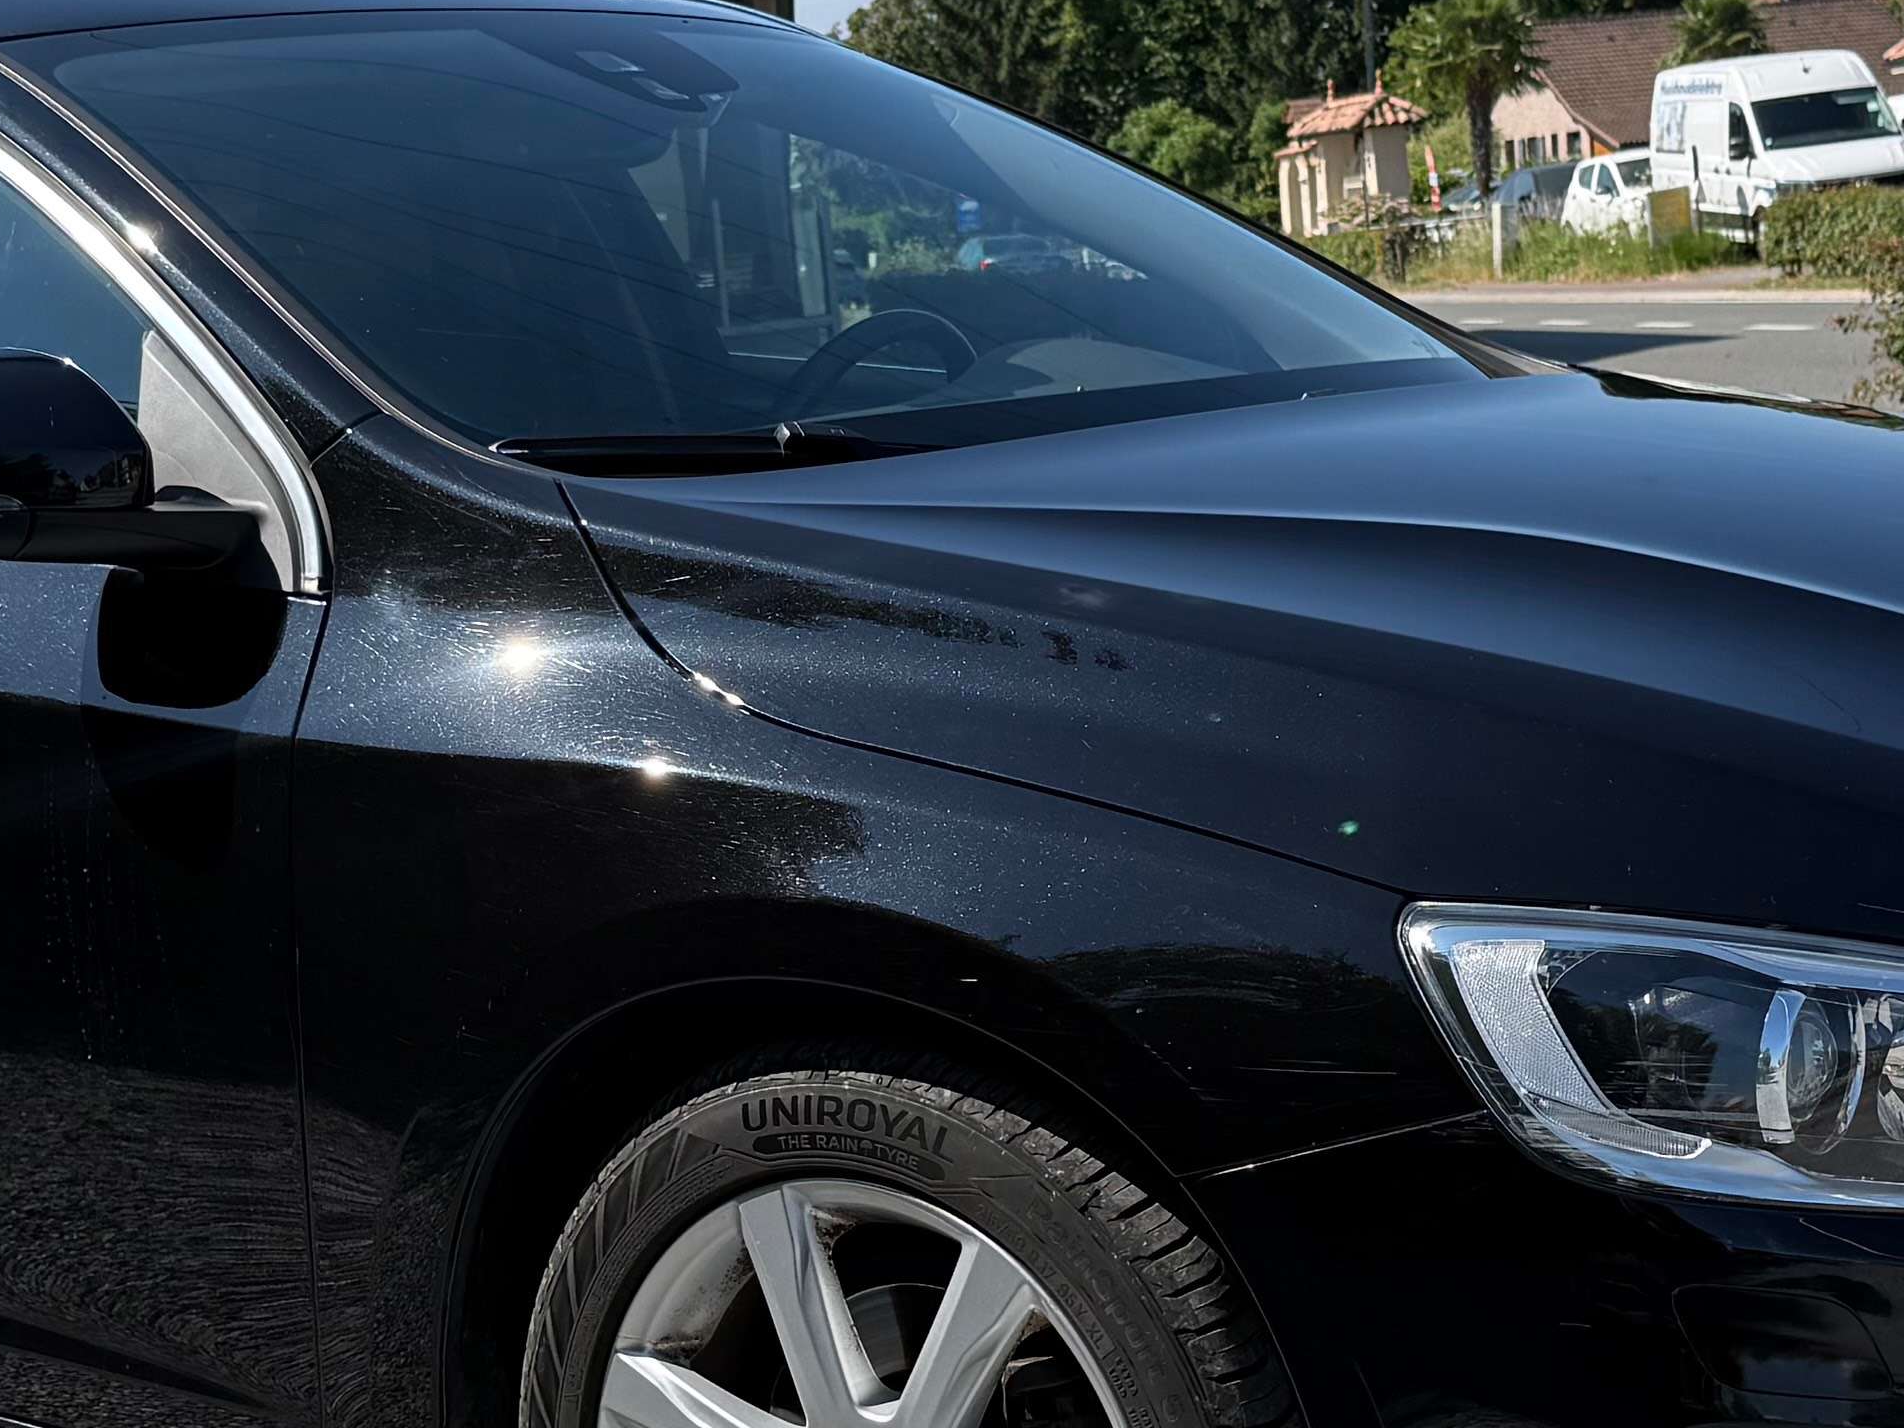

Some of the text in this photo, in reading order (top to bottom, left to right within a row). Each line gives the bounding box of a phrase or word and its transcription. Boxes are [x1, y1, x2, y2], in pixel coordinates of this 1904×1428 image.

[741, 1094, 955, 1164] UNIROYAL
[777, 1134, 920, 1170] THE RAIN TYRE
